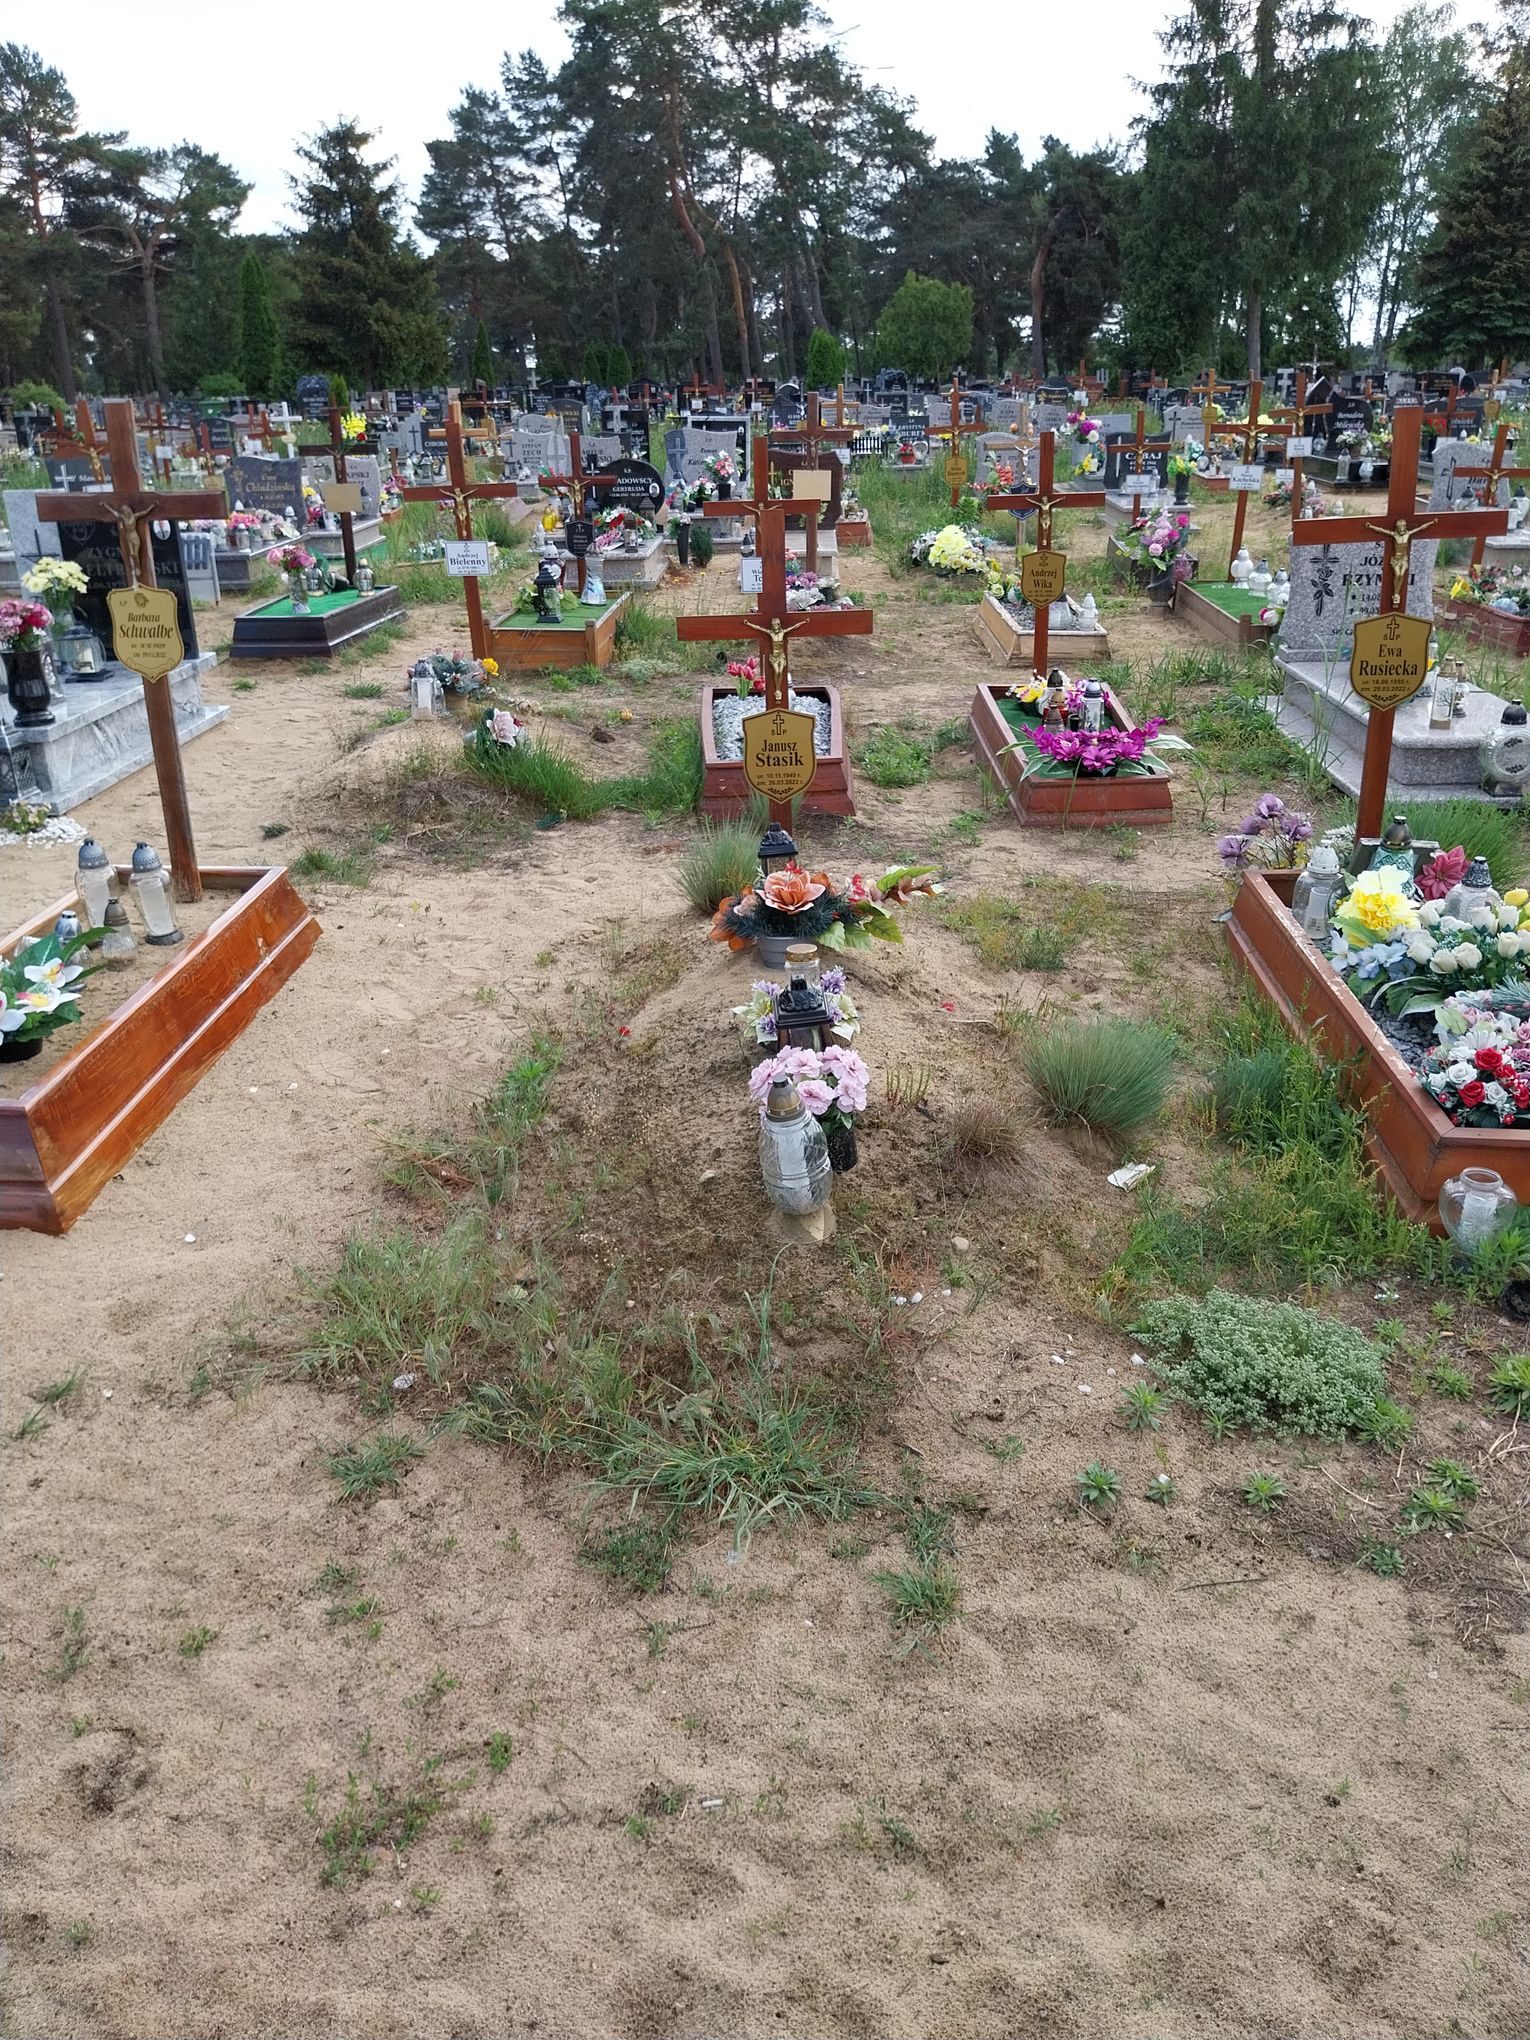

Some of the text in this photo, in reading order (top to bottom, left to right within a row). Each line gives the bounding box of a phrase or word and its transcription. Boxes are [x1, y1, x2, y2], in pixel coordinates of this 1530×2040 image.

[450, 558, 487, 567] Bielenny
[1030, 569, 1057, 579] Andrzej
[1033, 580, 1053, 589] Wika
[127, 612, 161, 623] Barbara
[119, 624, 174, 639] Schwalbe
[1378, 643, 1402, 658] Ewa
[1359, 660, 1418, 676] Rusiecka
[761, 740, 798, 752] Janusz
[755, 752, 804, 767] Stasik
